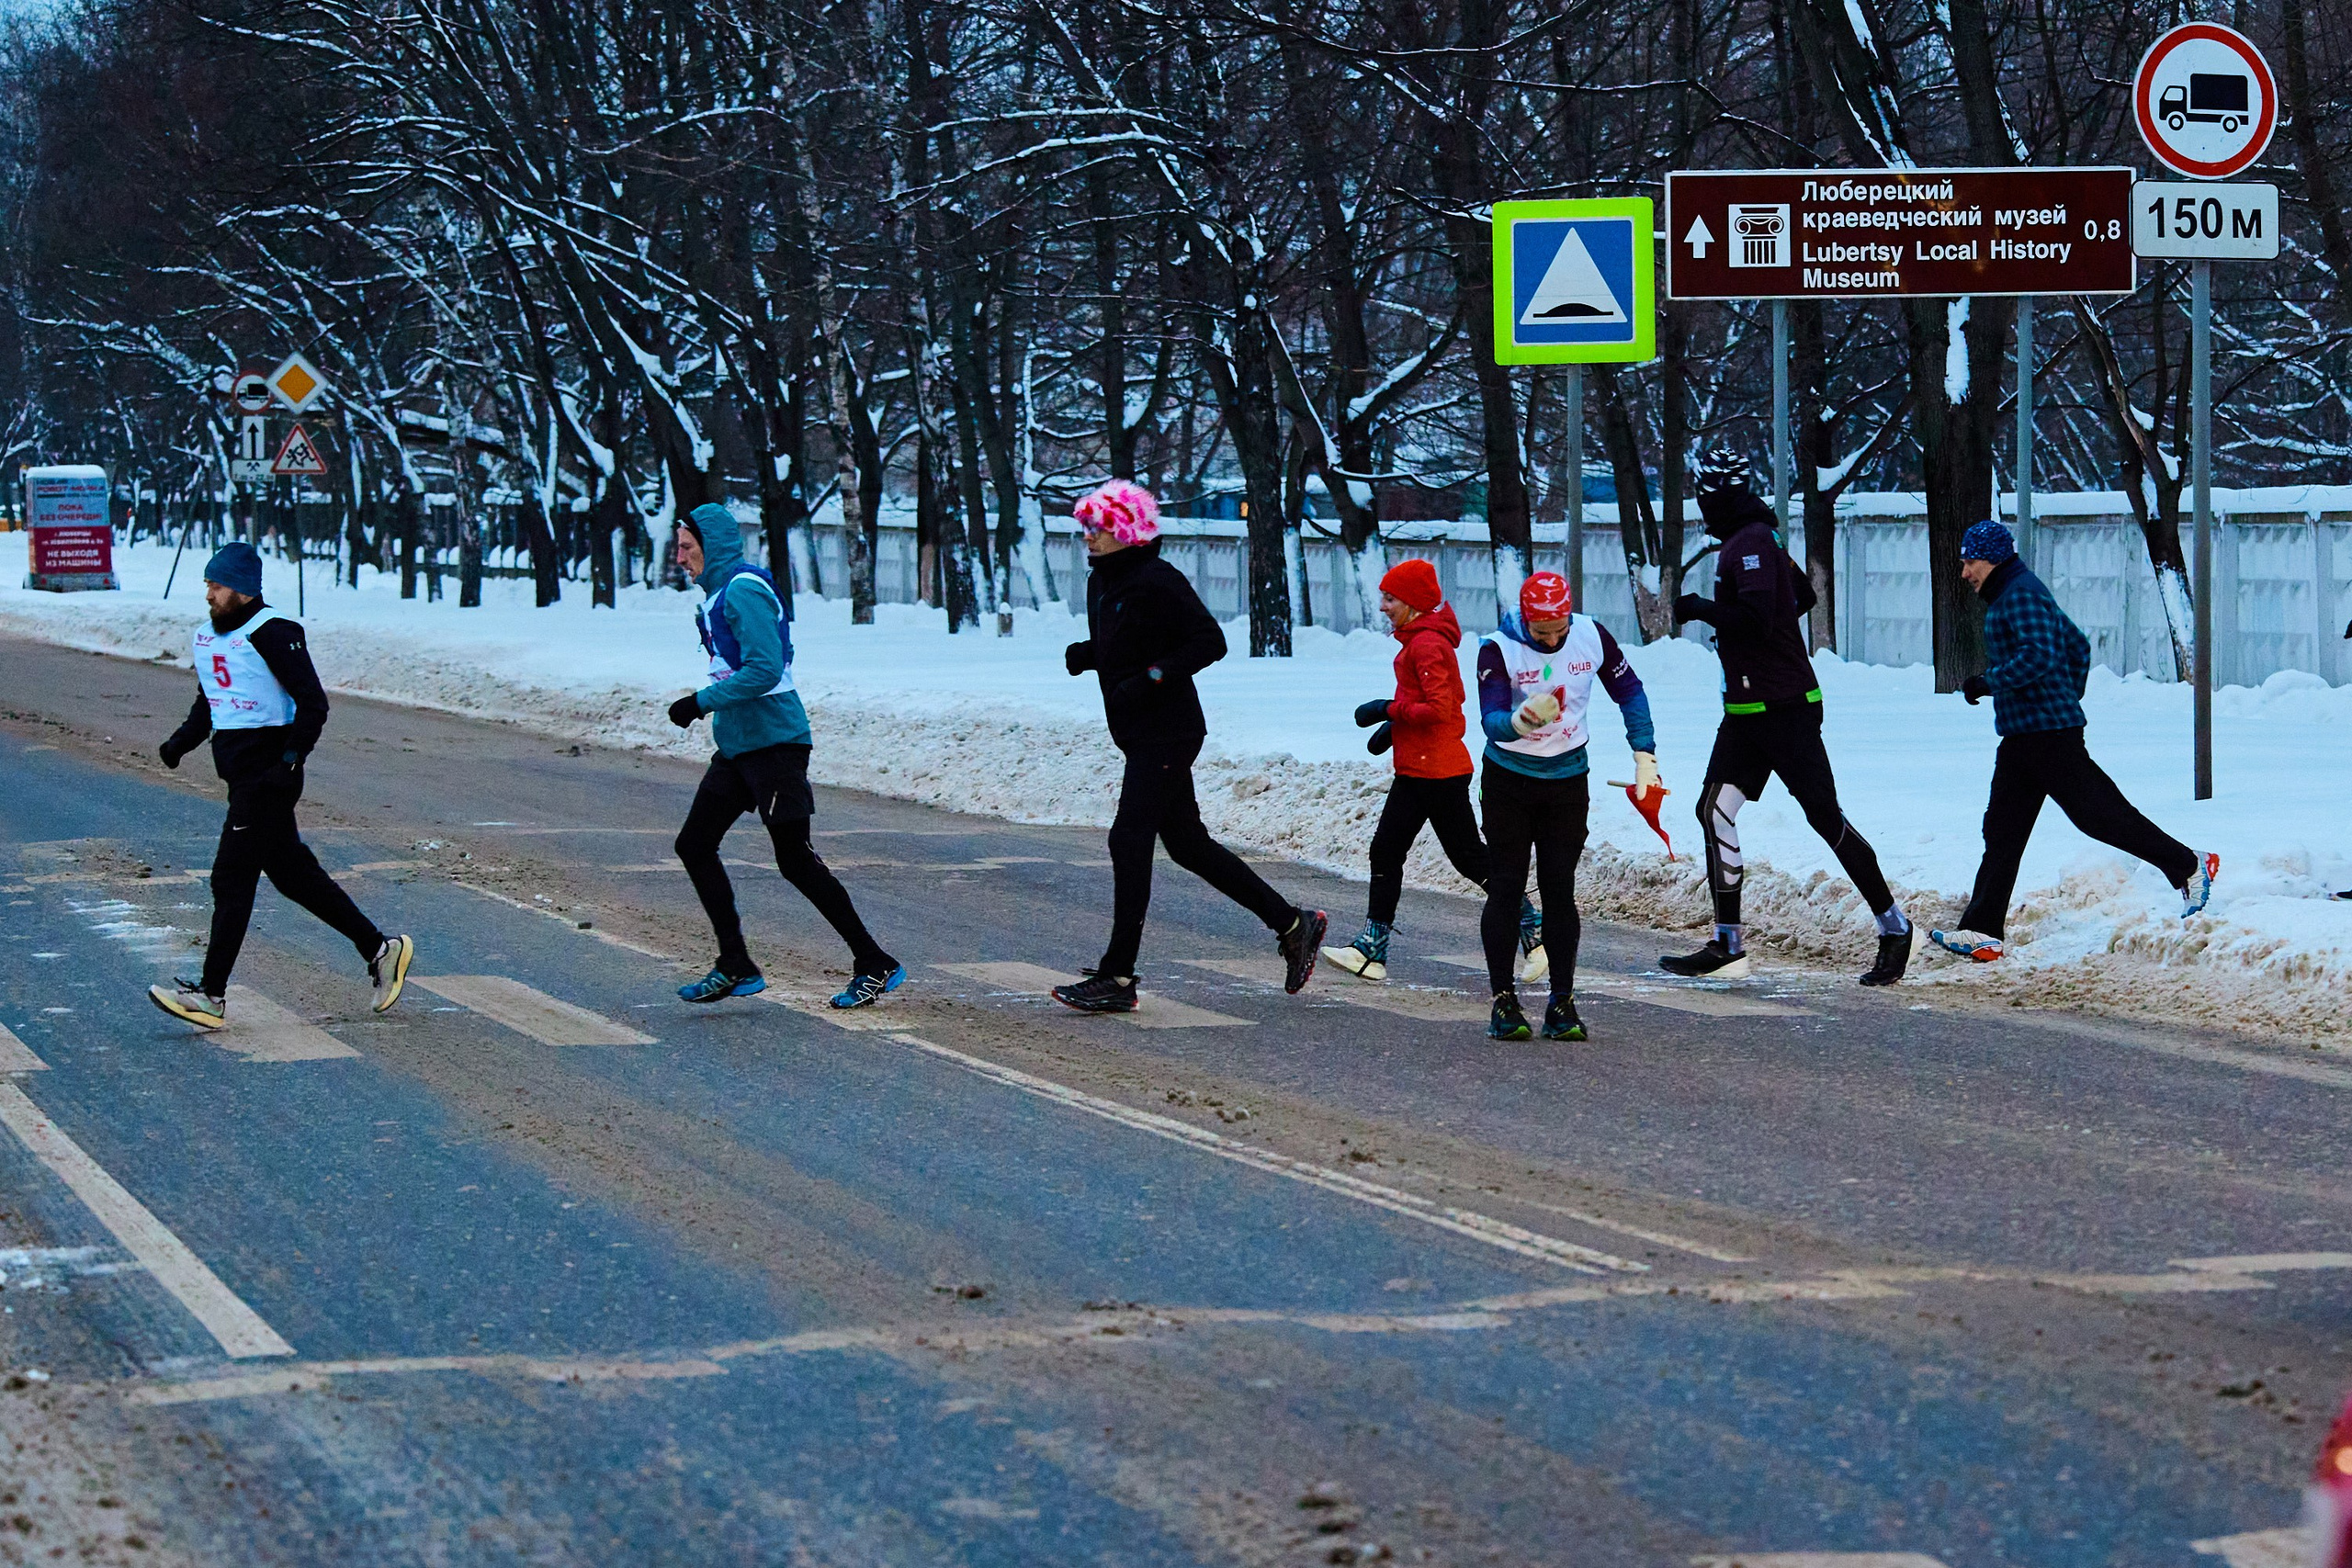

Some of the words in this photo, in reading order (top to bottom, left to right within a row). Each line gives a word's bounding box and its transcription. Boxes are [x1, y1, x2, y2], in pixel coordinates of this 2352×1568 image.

[1801, 178, 1953, 206] Люберецкий
[1803, 203, 1982, 233] краеведческий
[1995, 203, 2066, 231] музей
[2084, 219, 2121, 243] 0,8
[2148, 197, 2223, 239] 150
[1803, 242, 1904, 266] Lubertsy
[1916, 239, 1977, 261] Local
[1990, 239, 2072, 265] History
[1803, 267, 1900, 288] Museum
[61, 549, 98, 558] ВЫХОДЯ
[212, 653, 232, 689] 5
